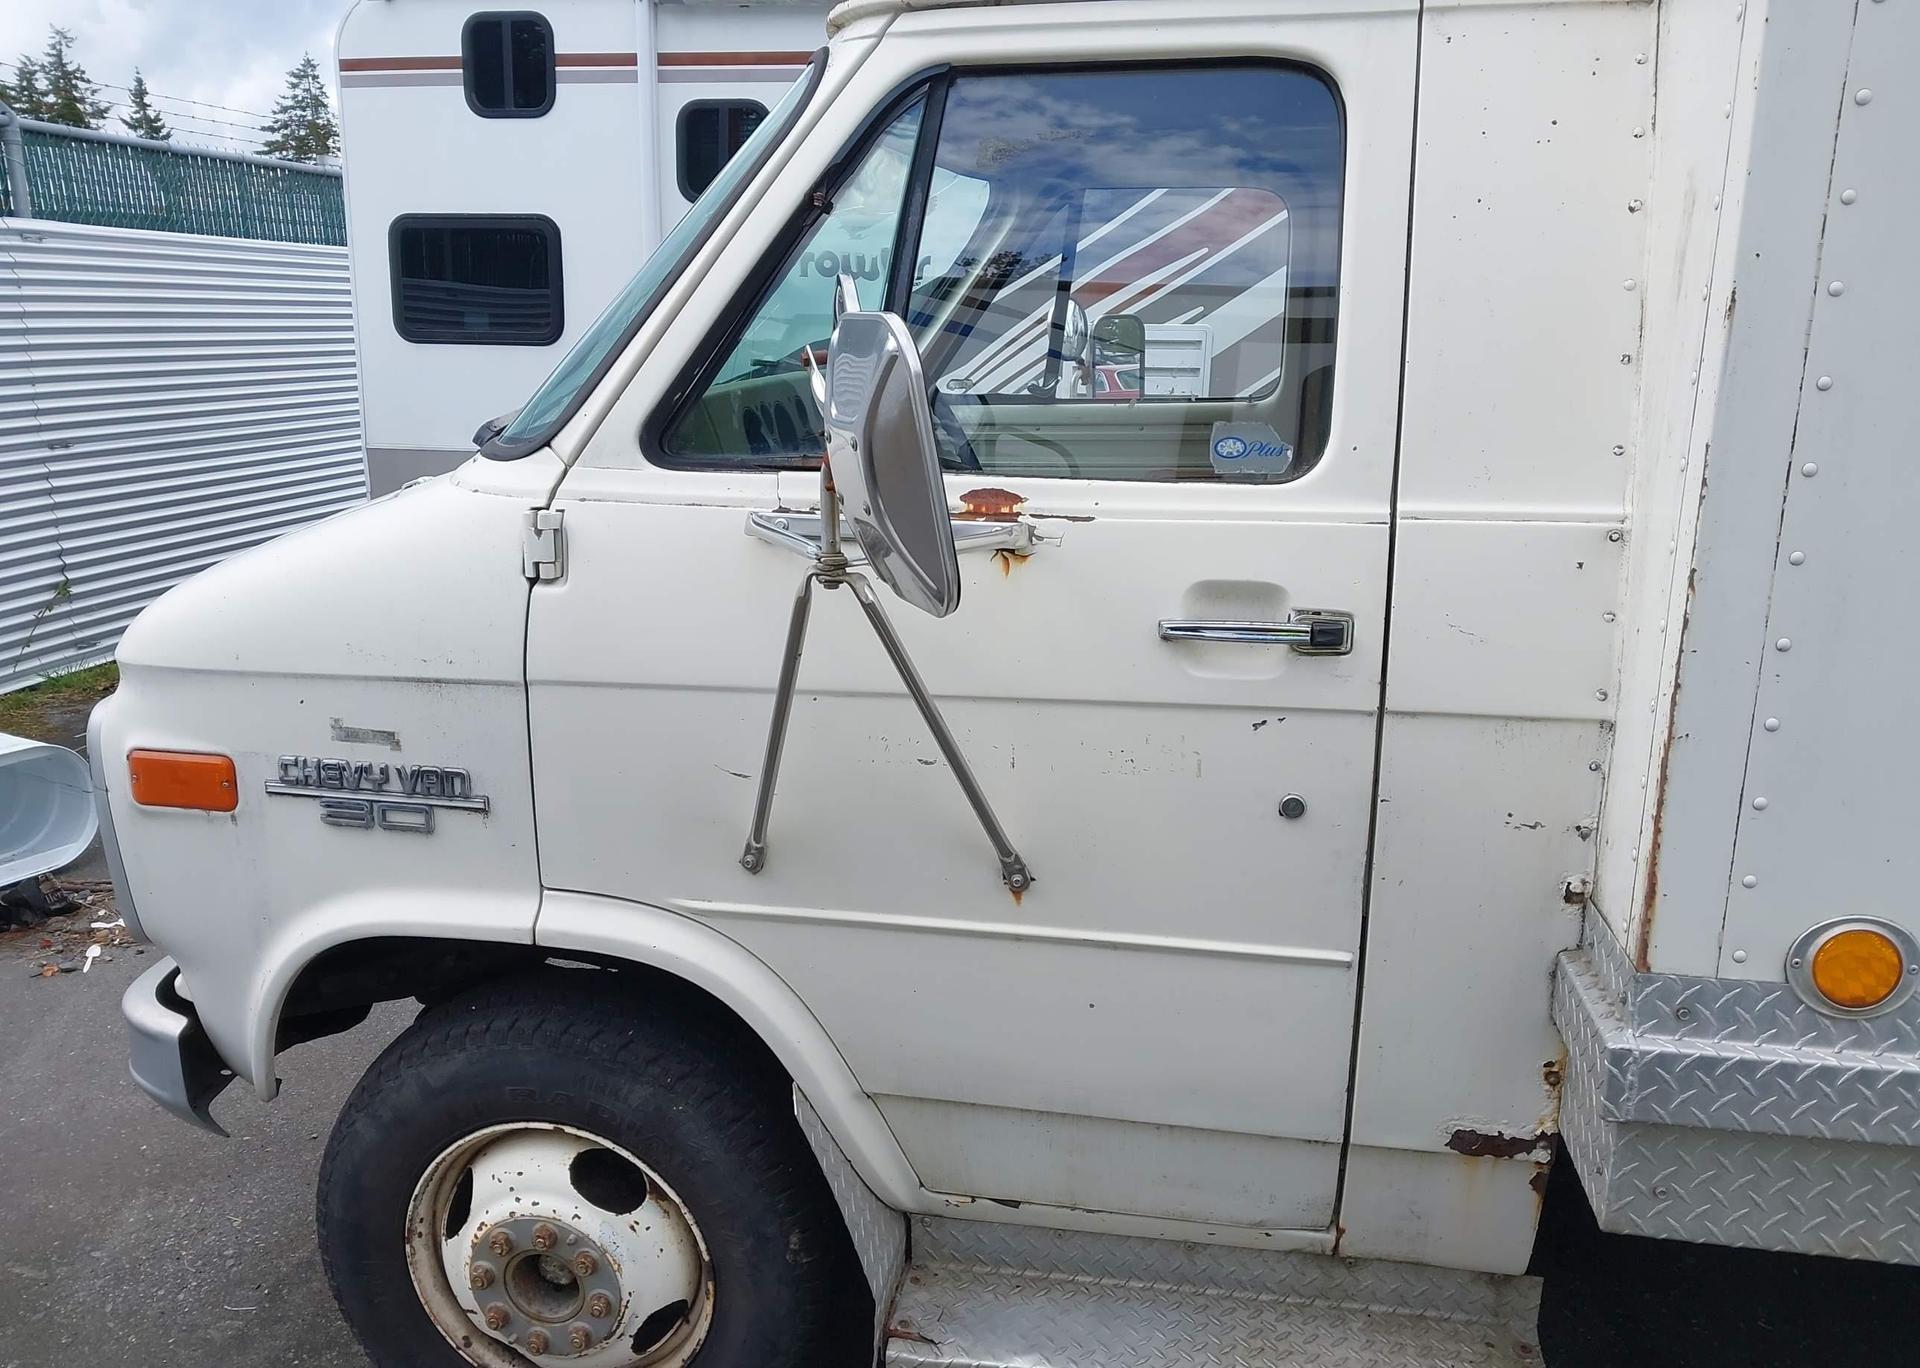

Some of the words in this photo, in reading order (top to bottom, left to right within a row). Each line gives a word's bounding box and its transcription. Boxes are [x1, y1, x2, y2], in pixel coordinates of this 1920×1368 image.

[1241, 440, 1287, 459] Plus
[278, 754, 390, 792] CHEVY
[394, 764, 472, 798] VAN
[319, 799, 436, 834] 30
